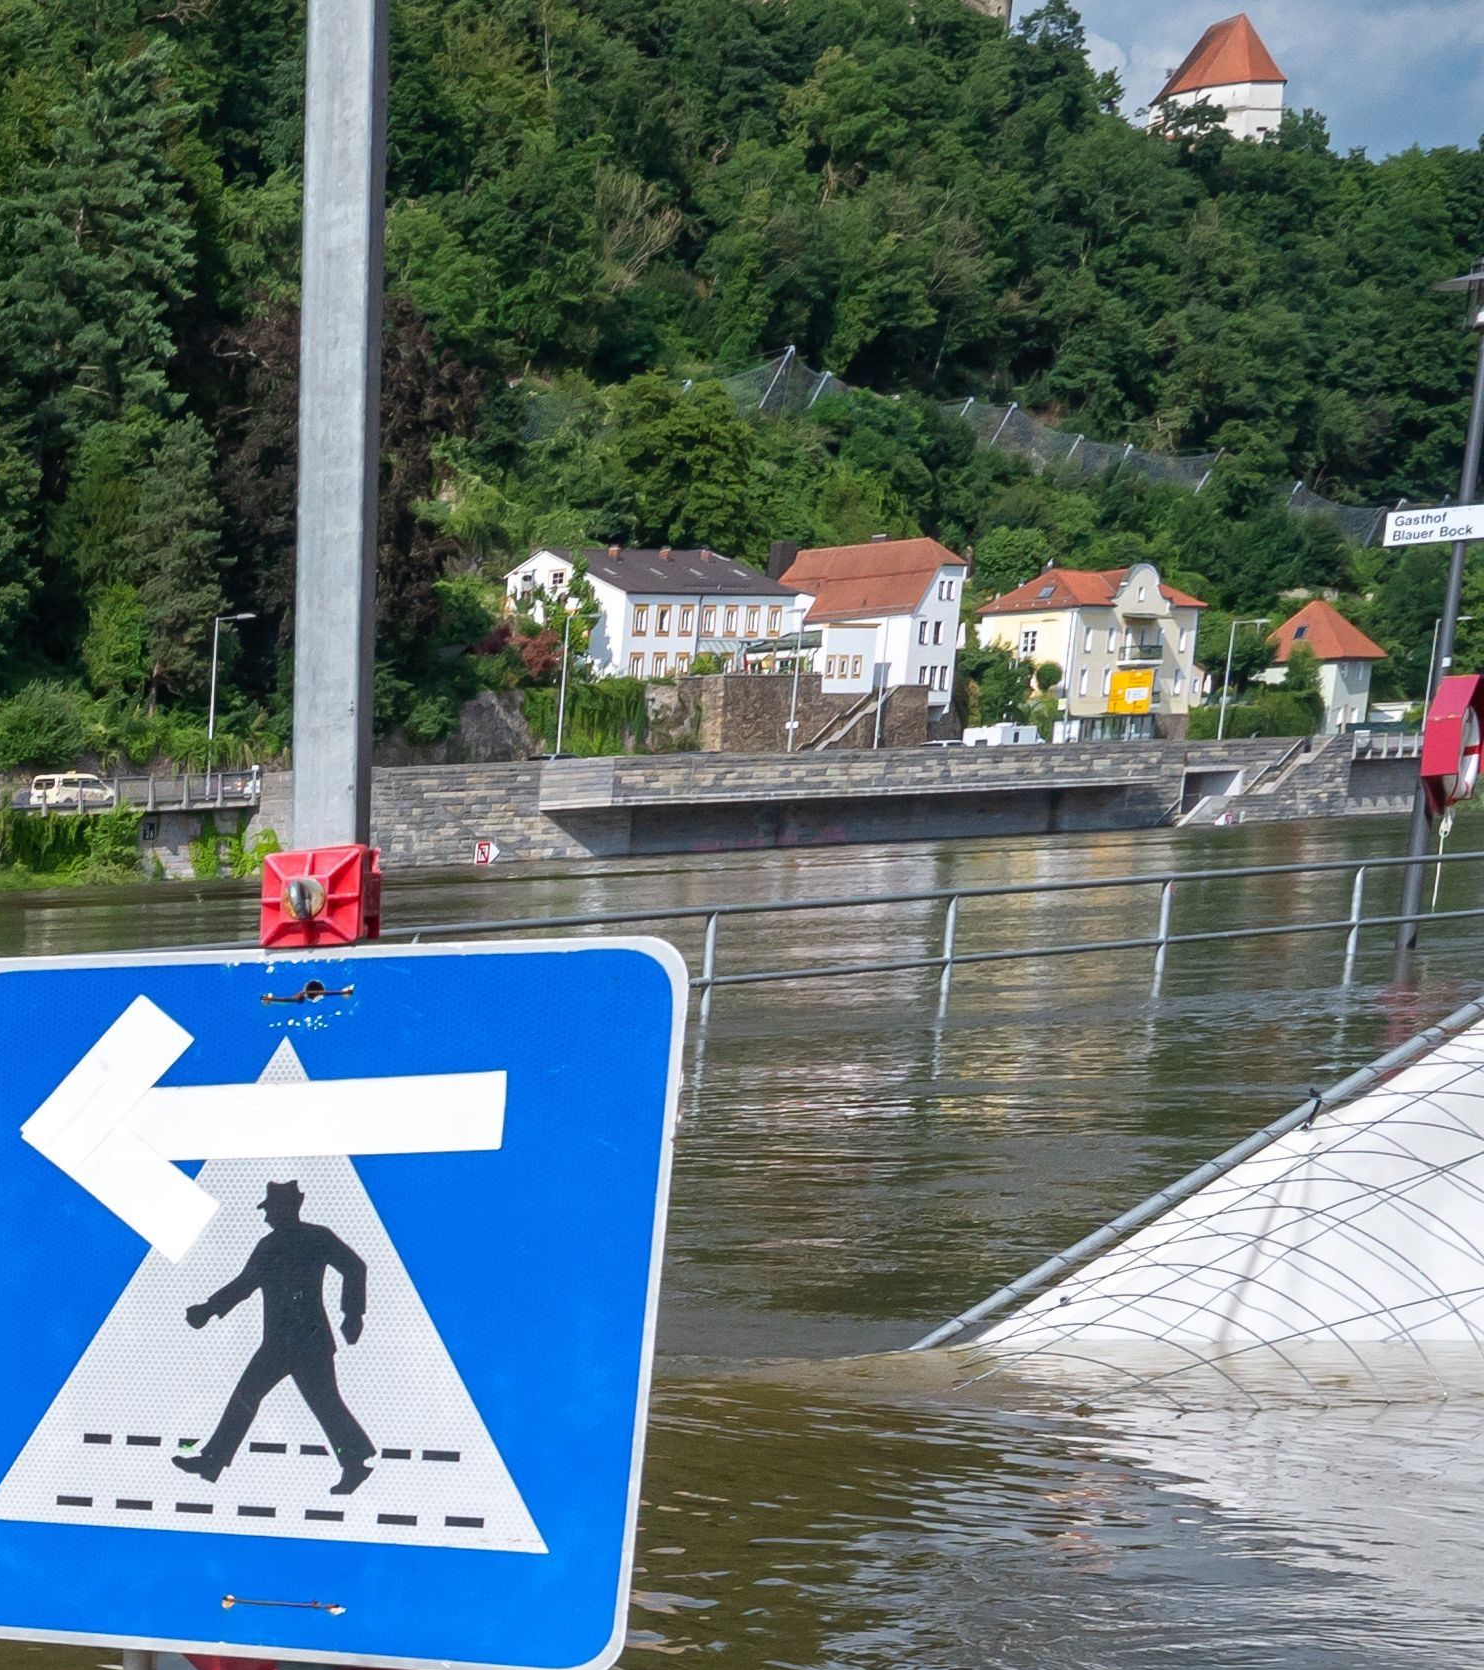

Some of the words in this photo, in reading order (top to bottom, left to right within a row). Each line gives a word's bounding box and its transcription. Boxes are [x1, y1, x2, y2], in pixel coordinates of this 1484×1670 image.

[1395, 512, 1447, 526] Gasthof
[1393, 530, 1434, 541] Blauer
[1440, 524, 1473, 537] Bock
